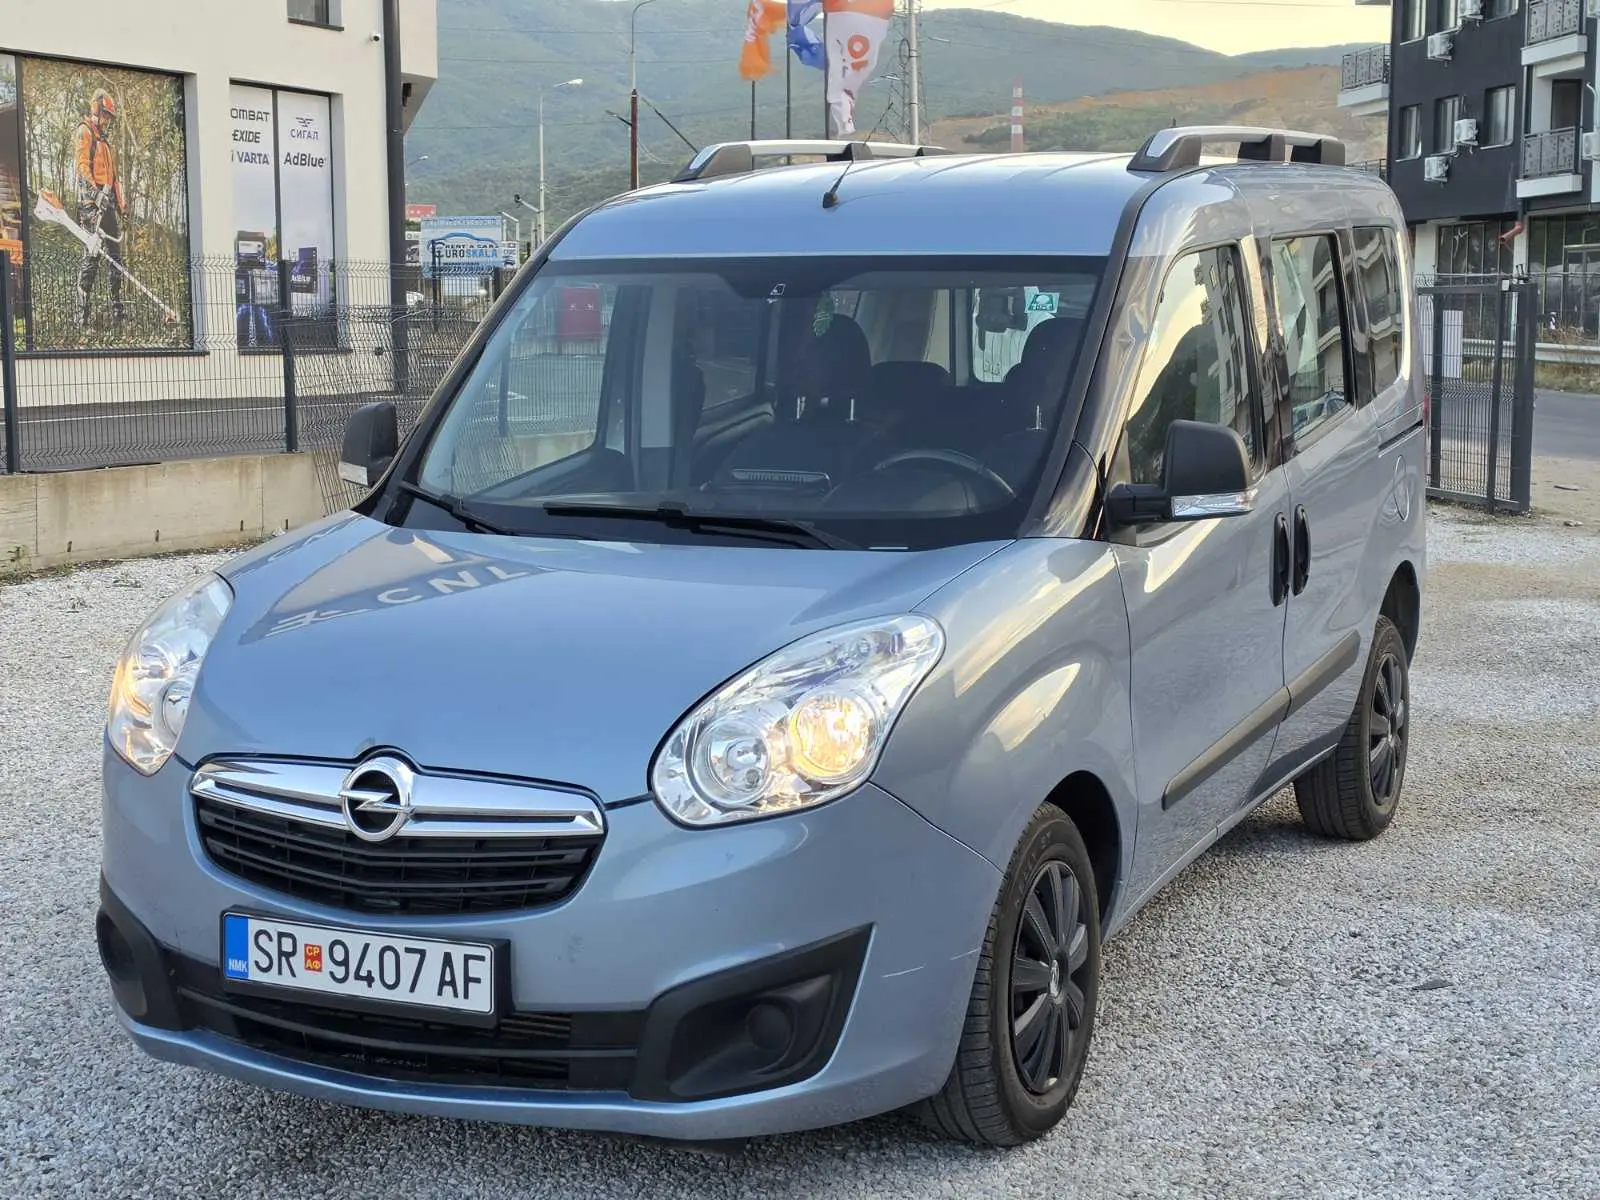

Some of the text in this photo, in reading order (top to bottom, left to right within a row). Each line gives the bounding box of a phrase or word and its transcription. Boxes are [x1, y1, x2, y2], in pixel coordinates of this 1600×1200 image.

[283, 152, 325, 168] AdBlue
[228, 958, 249, 973] NMK
[254, 929, 486, 1000] SR 9407 AF
